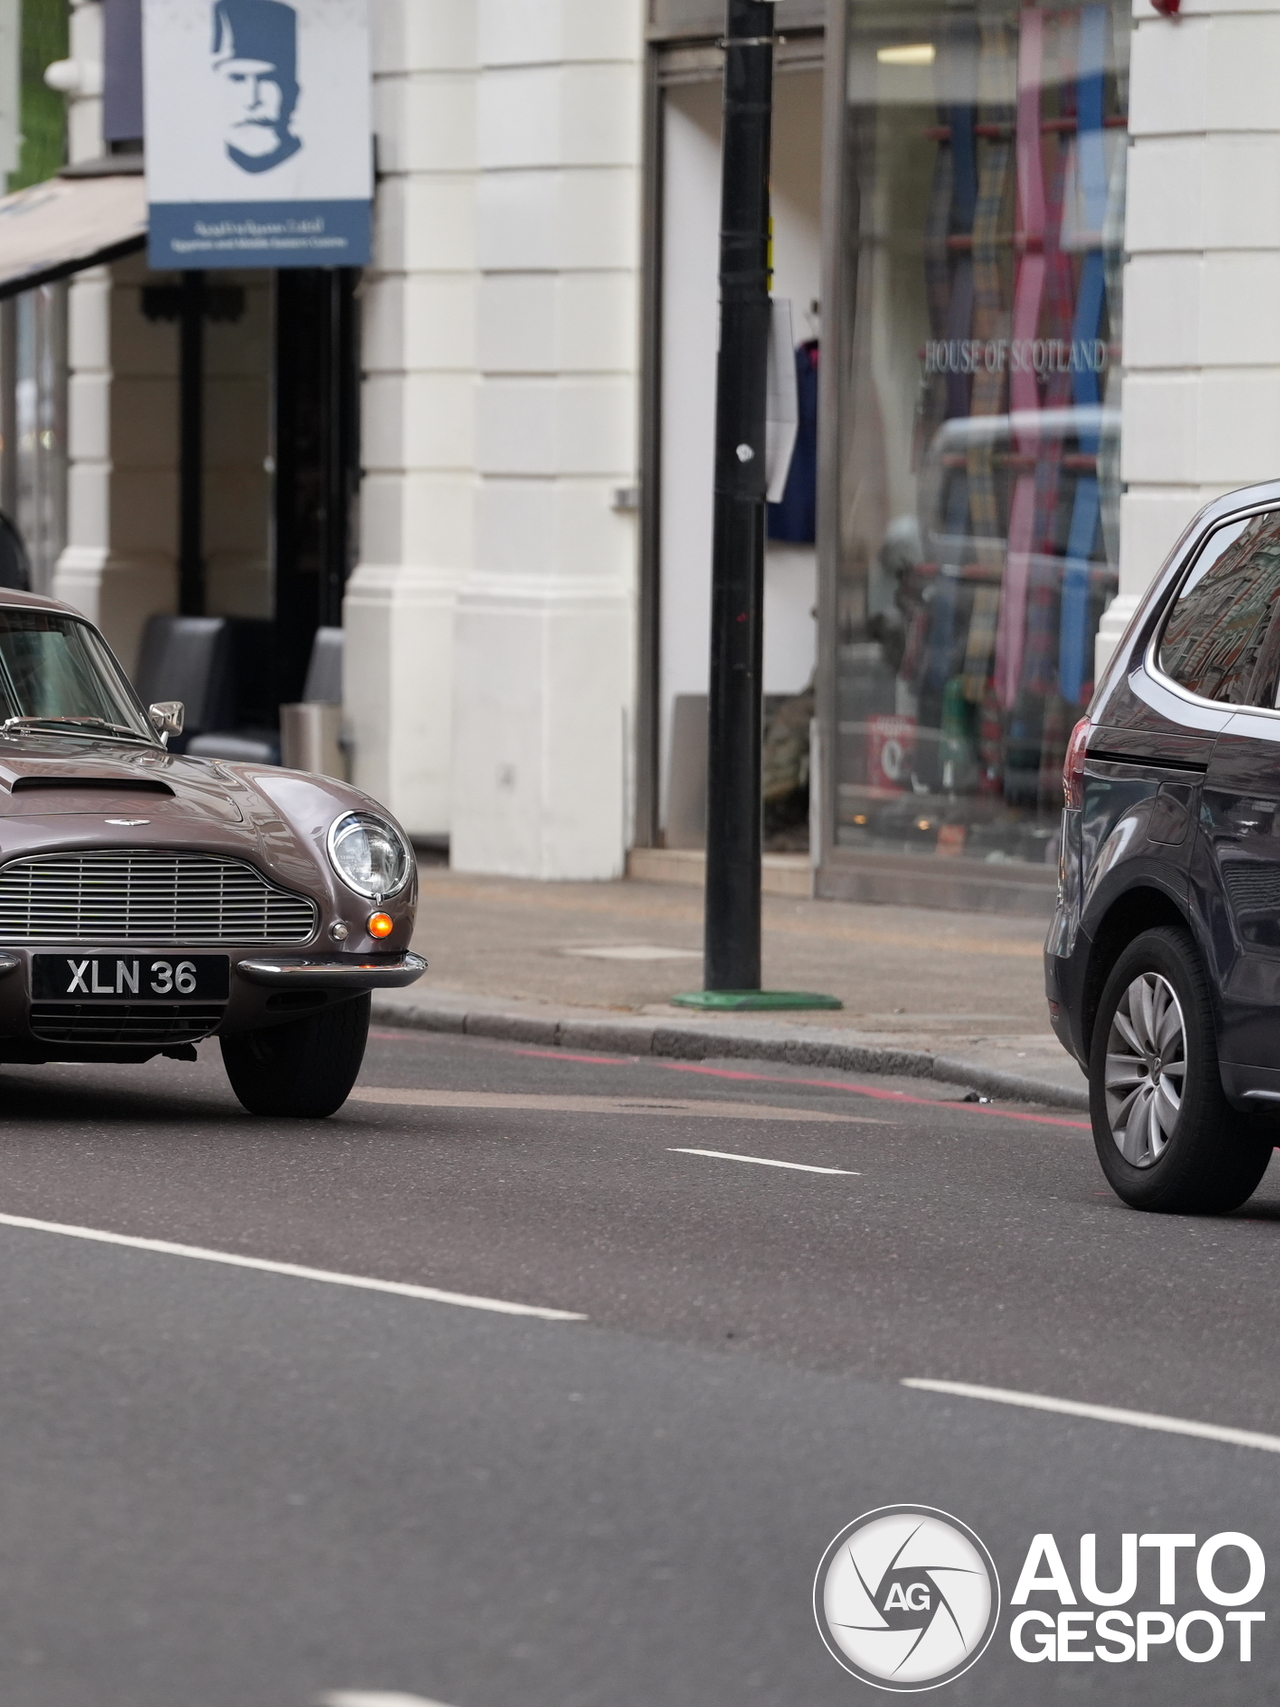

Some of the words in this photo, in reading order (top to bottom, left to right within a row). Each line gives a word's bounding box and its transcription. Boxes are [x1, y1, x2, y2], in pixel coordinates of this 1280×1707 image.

[925, 340, 981, 372] HOUSE
[984, 340, 1006, 372] OF
[1011, 340, 1108, 372] SCOTLAND
[66, 959, 140, 994] XLN
[150, 960, 197, 994] 36
